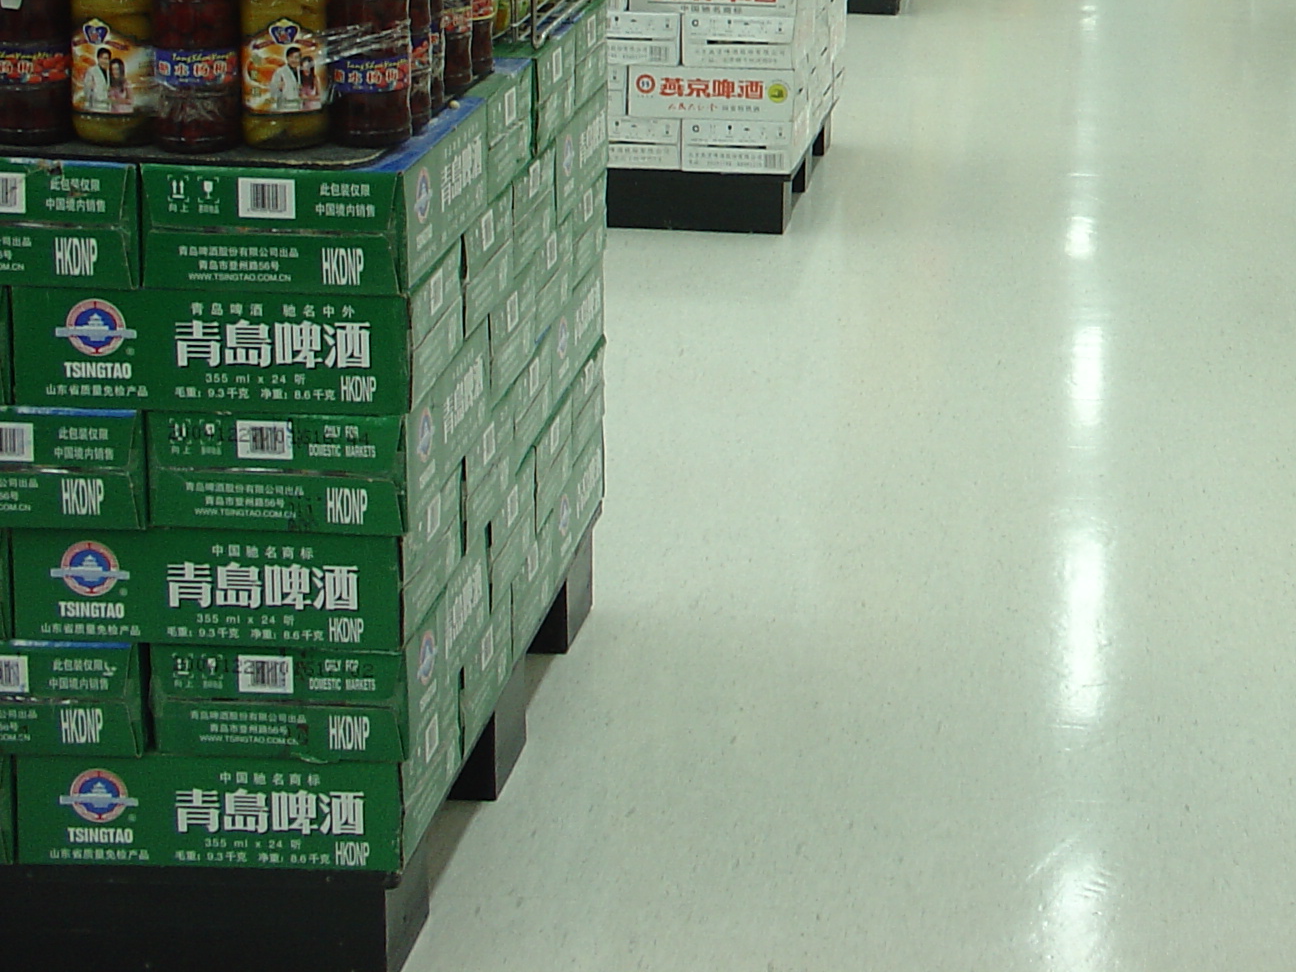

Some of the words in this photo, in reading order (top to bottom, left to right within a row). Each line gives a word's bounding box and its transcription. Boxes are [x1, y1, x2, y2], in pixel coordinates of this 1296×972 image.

[659, 78, 763, 99] 燕京啤酒
[320, 183, 371, 197] 此包装仅限
[45, 198, 106, 212] 中国境内销售
[315, 204, 375, 218] 中国境内销售
[54, 237, 97, 275] HKDNP
[322, 248, 364, 285] HKDNP
[189, 273, 291, 282] WWW.TSINGTAO.COM.CN
[175, 319, 371, 368] 青島啤酒
[64, 362, 132, 379] TSINGTAO
[205, 373, 227, 383] 355
[272, 374, 286, 384] 24
[341, 376, 376, 402] HKDNP
[309, 444, 341, 457] DOMESTIC
[345, 445, 375, 458] MARKETS
[62, 479, 104, 515] HKDNP
[326, 488, 367, 524] HKDNP
[166, 562, 358, 611] 青島啤酒
[58, 601, 124, 618] TSINGTAO
[197, 615, 219, 624] 355
[261, 615, 276, 625] 24
[329, 618, 364, 642] HKDNP
[175, 789, 364, 835] 青島啤酒
[67, 828, 133, 843] TSINGTAO
